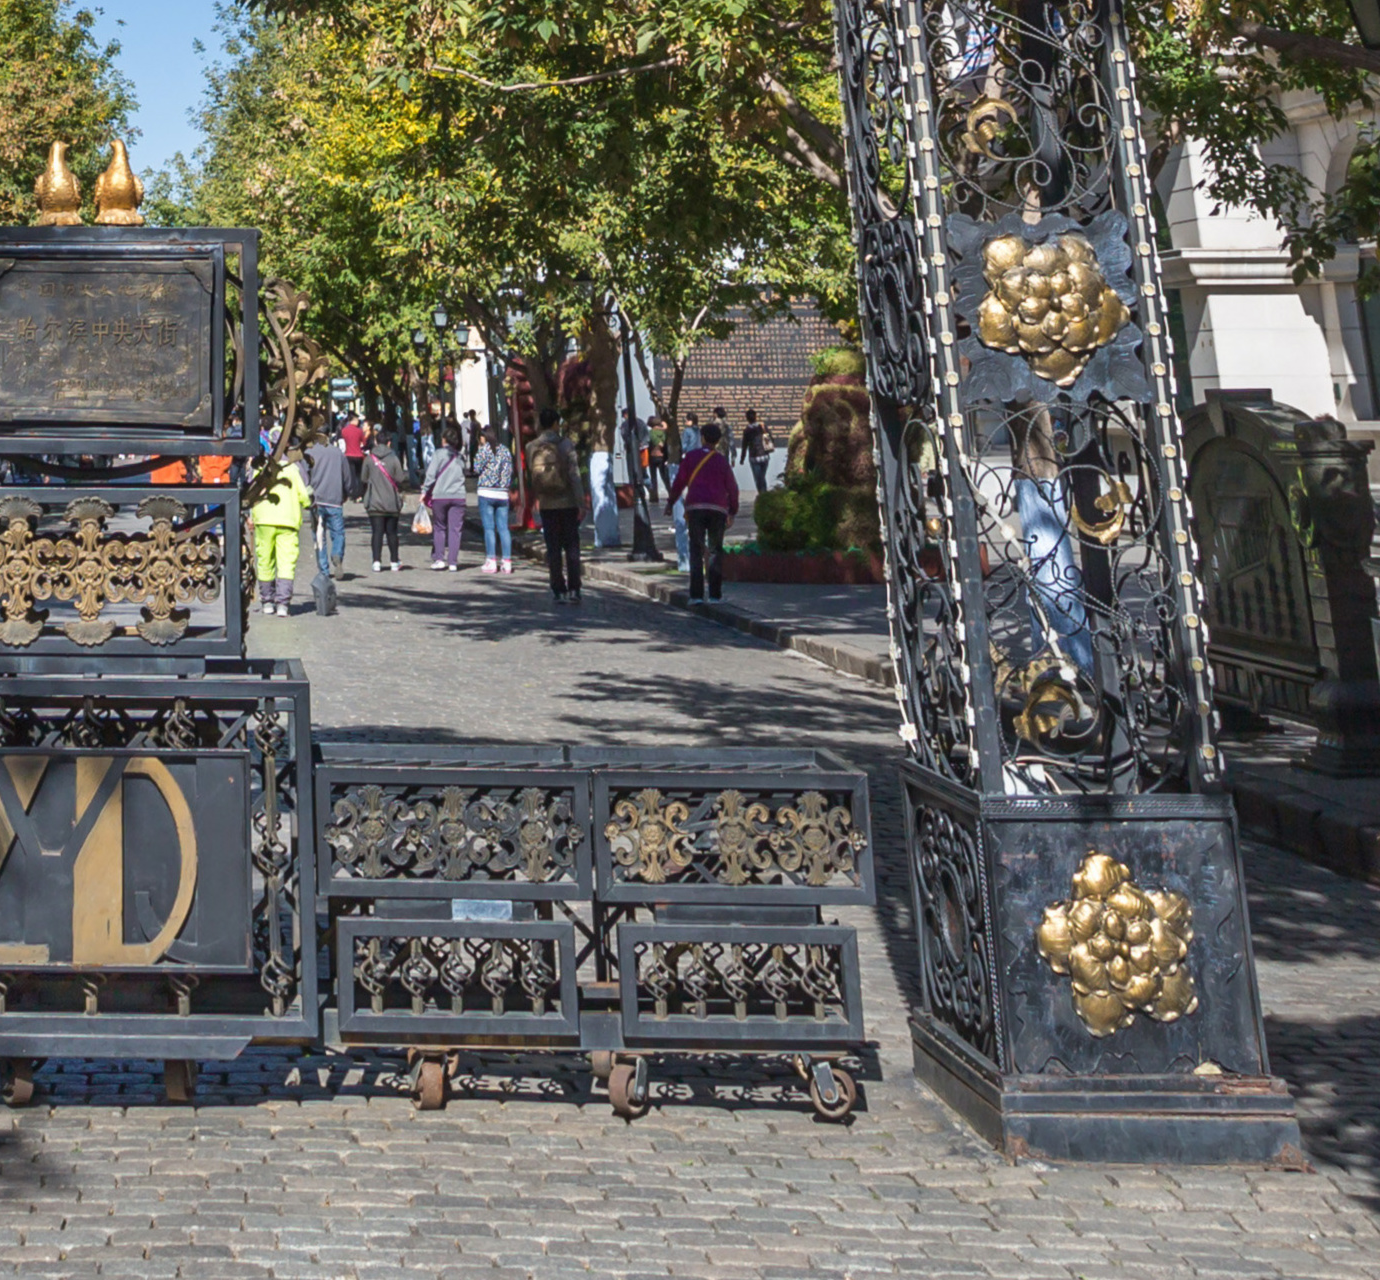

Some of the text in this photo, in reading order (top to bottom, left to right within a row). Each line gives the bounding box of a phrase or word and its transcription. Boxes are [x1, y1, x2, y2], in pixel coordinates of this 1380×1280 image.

[16, 315, 182, 348] 哈尔滨中央大街
